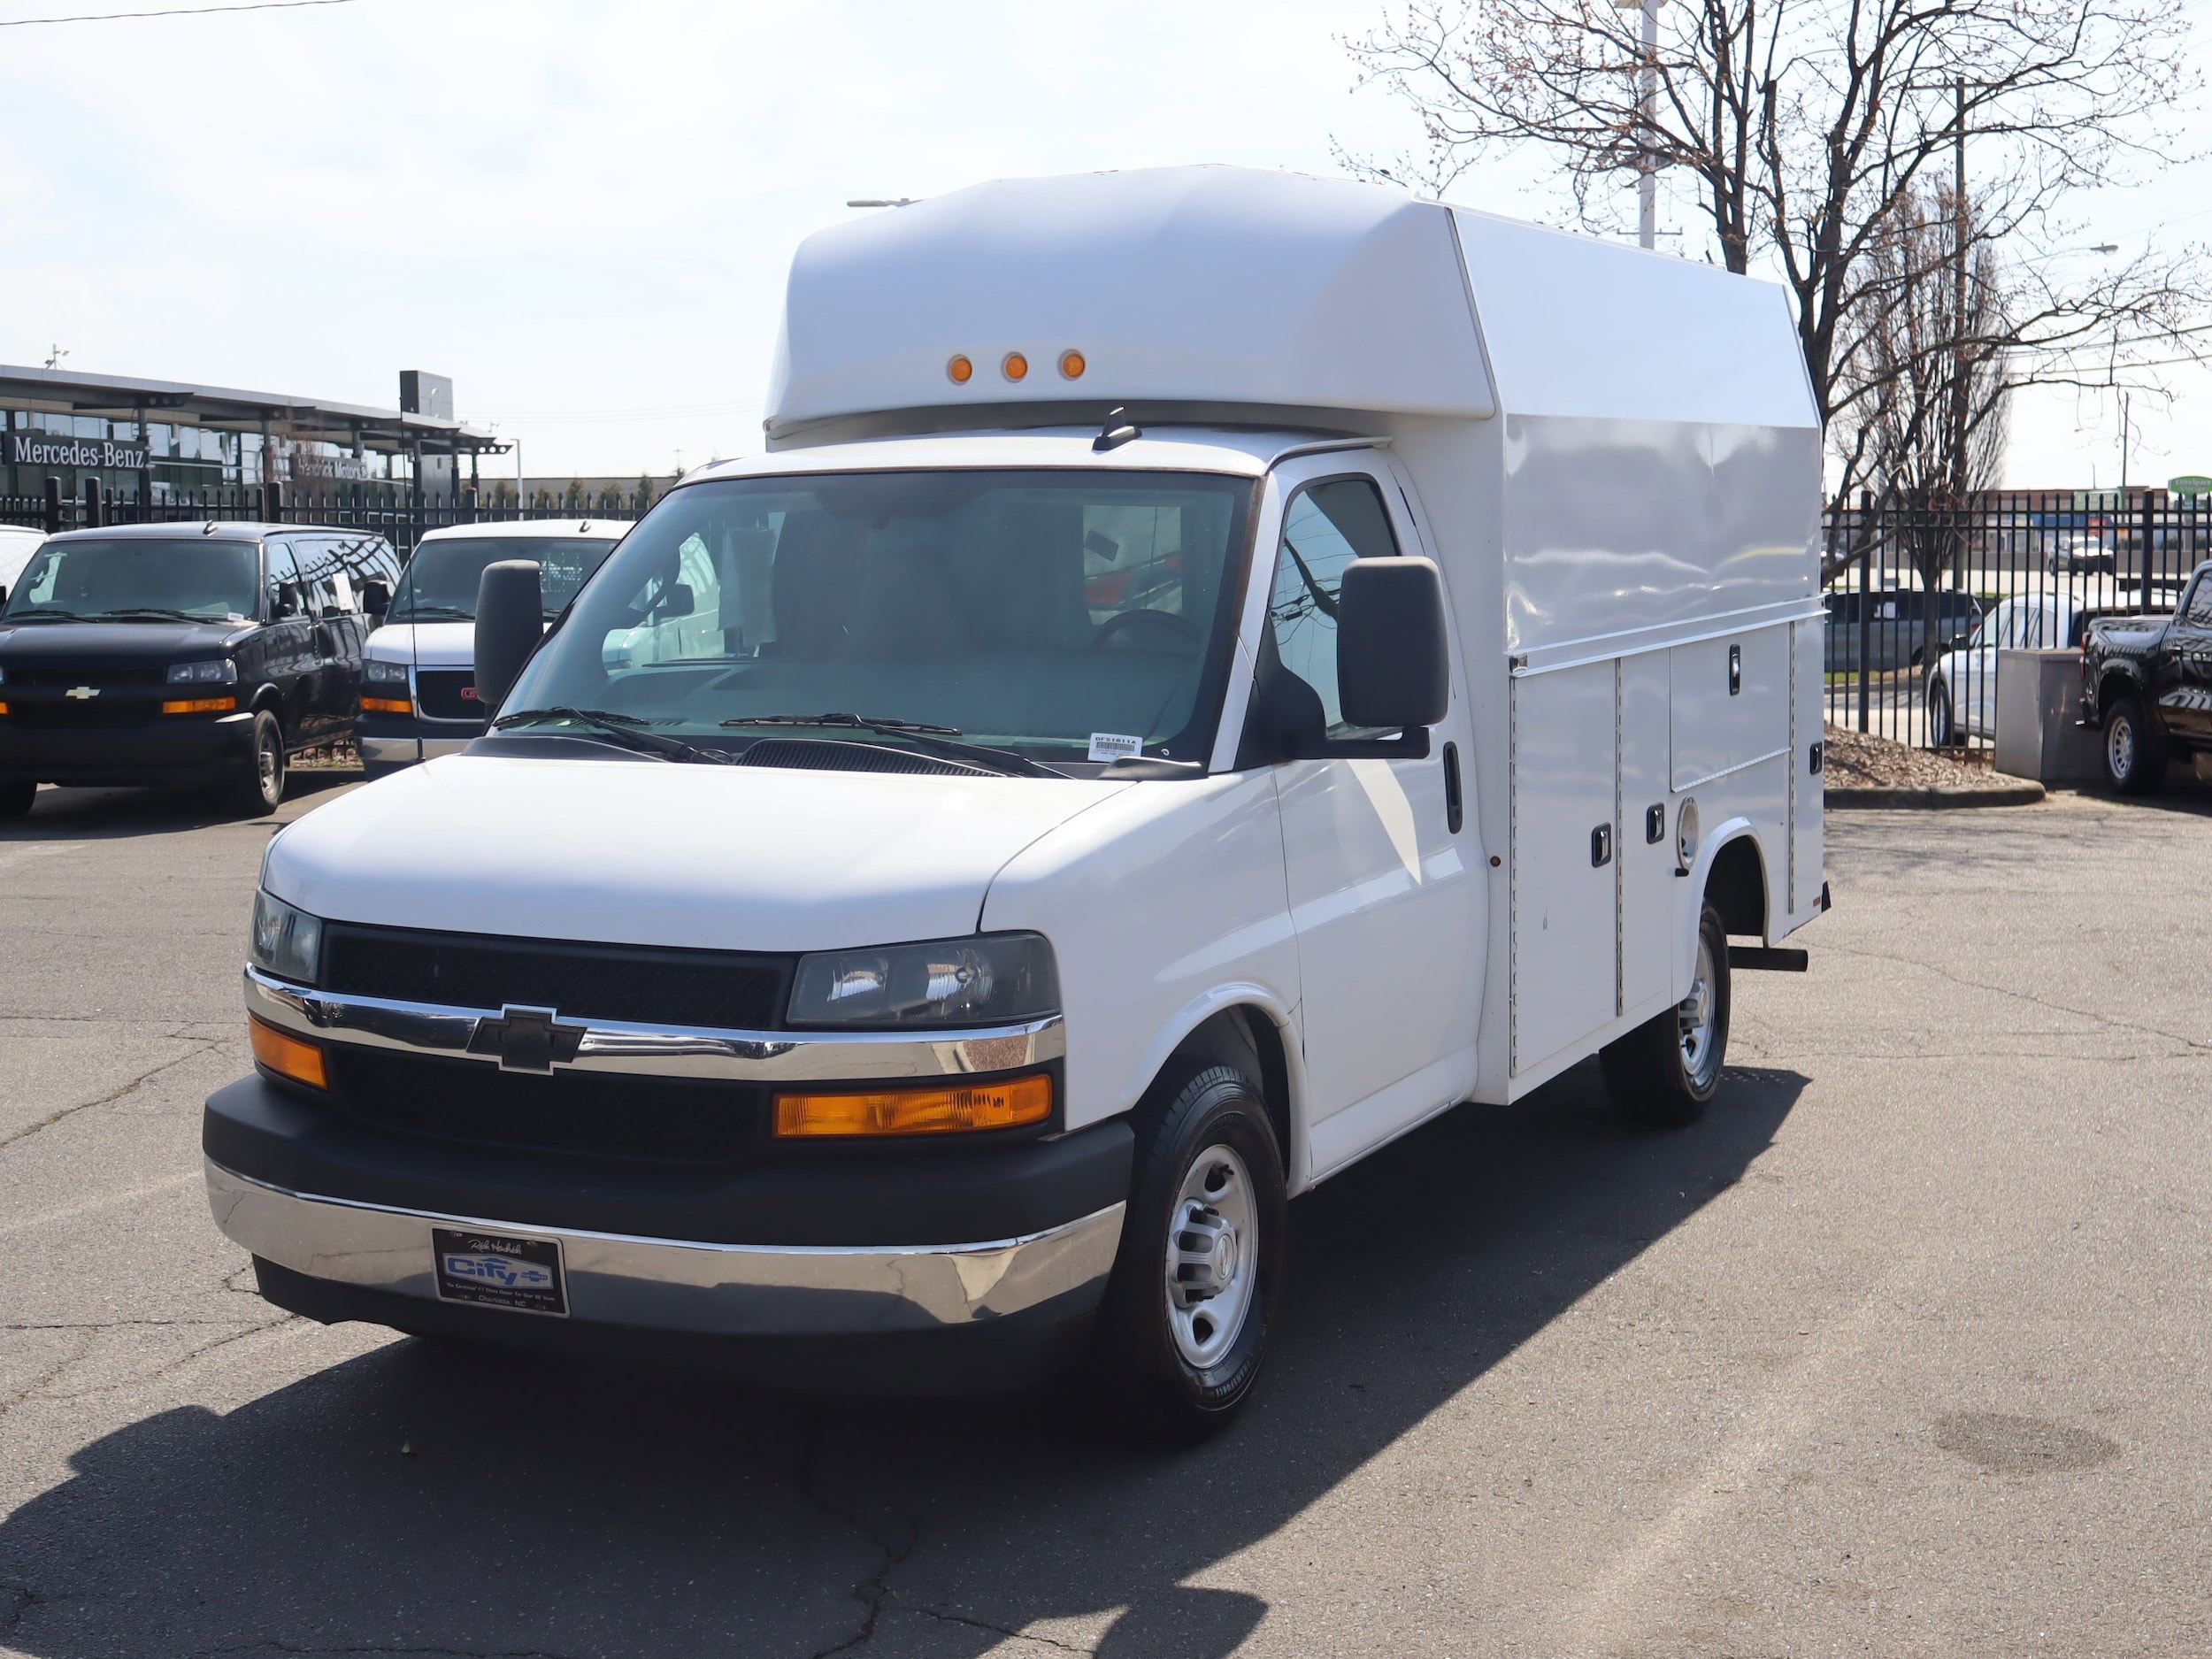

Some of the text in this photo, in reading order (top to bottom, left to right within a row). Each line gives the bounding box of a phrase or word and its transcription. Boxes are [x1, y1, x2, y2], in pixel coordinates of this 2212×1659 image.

[14, 436, 144, 468] Mercedes-Benz
[335, 460, 361, 479] Motors
[448, 1257, 518, 1286] City
